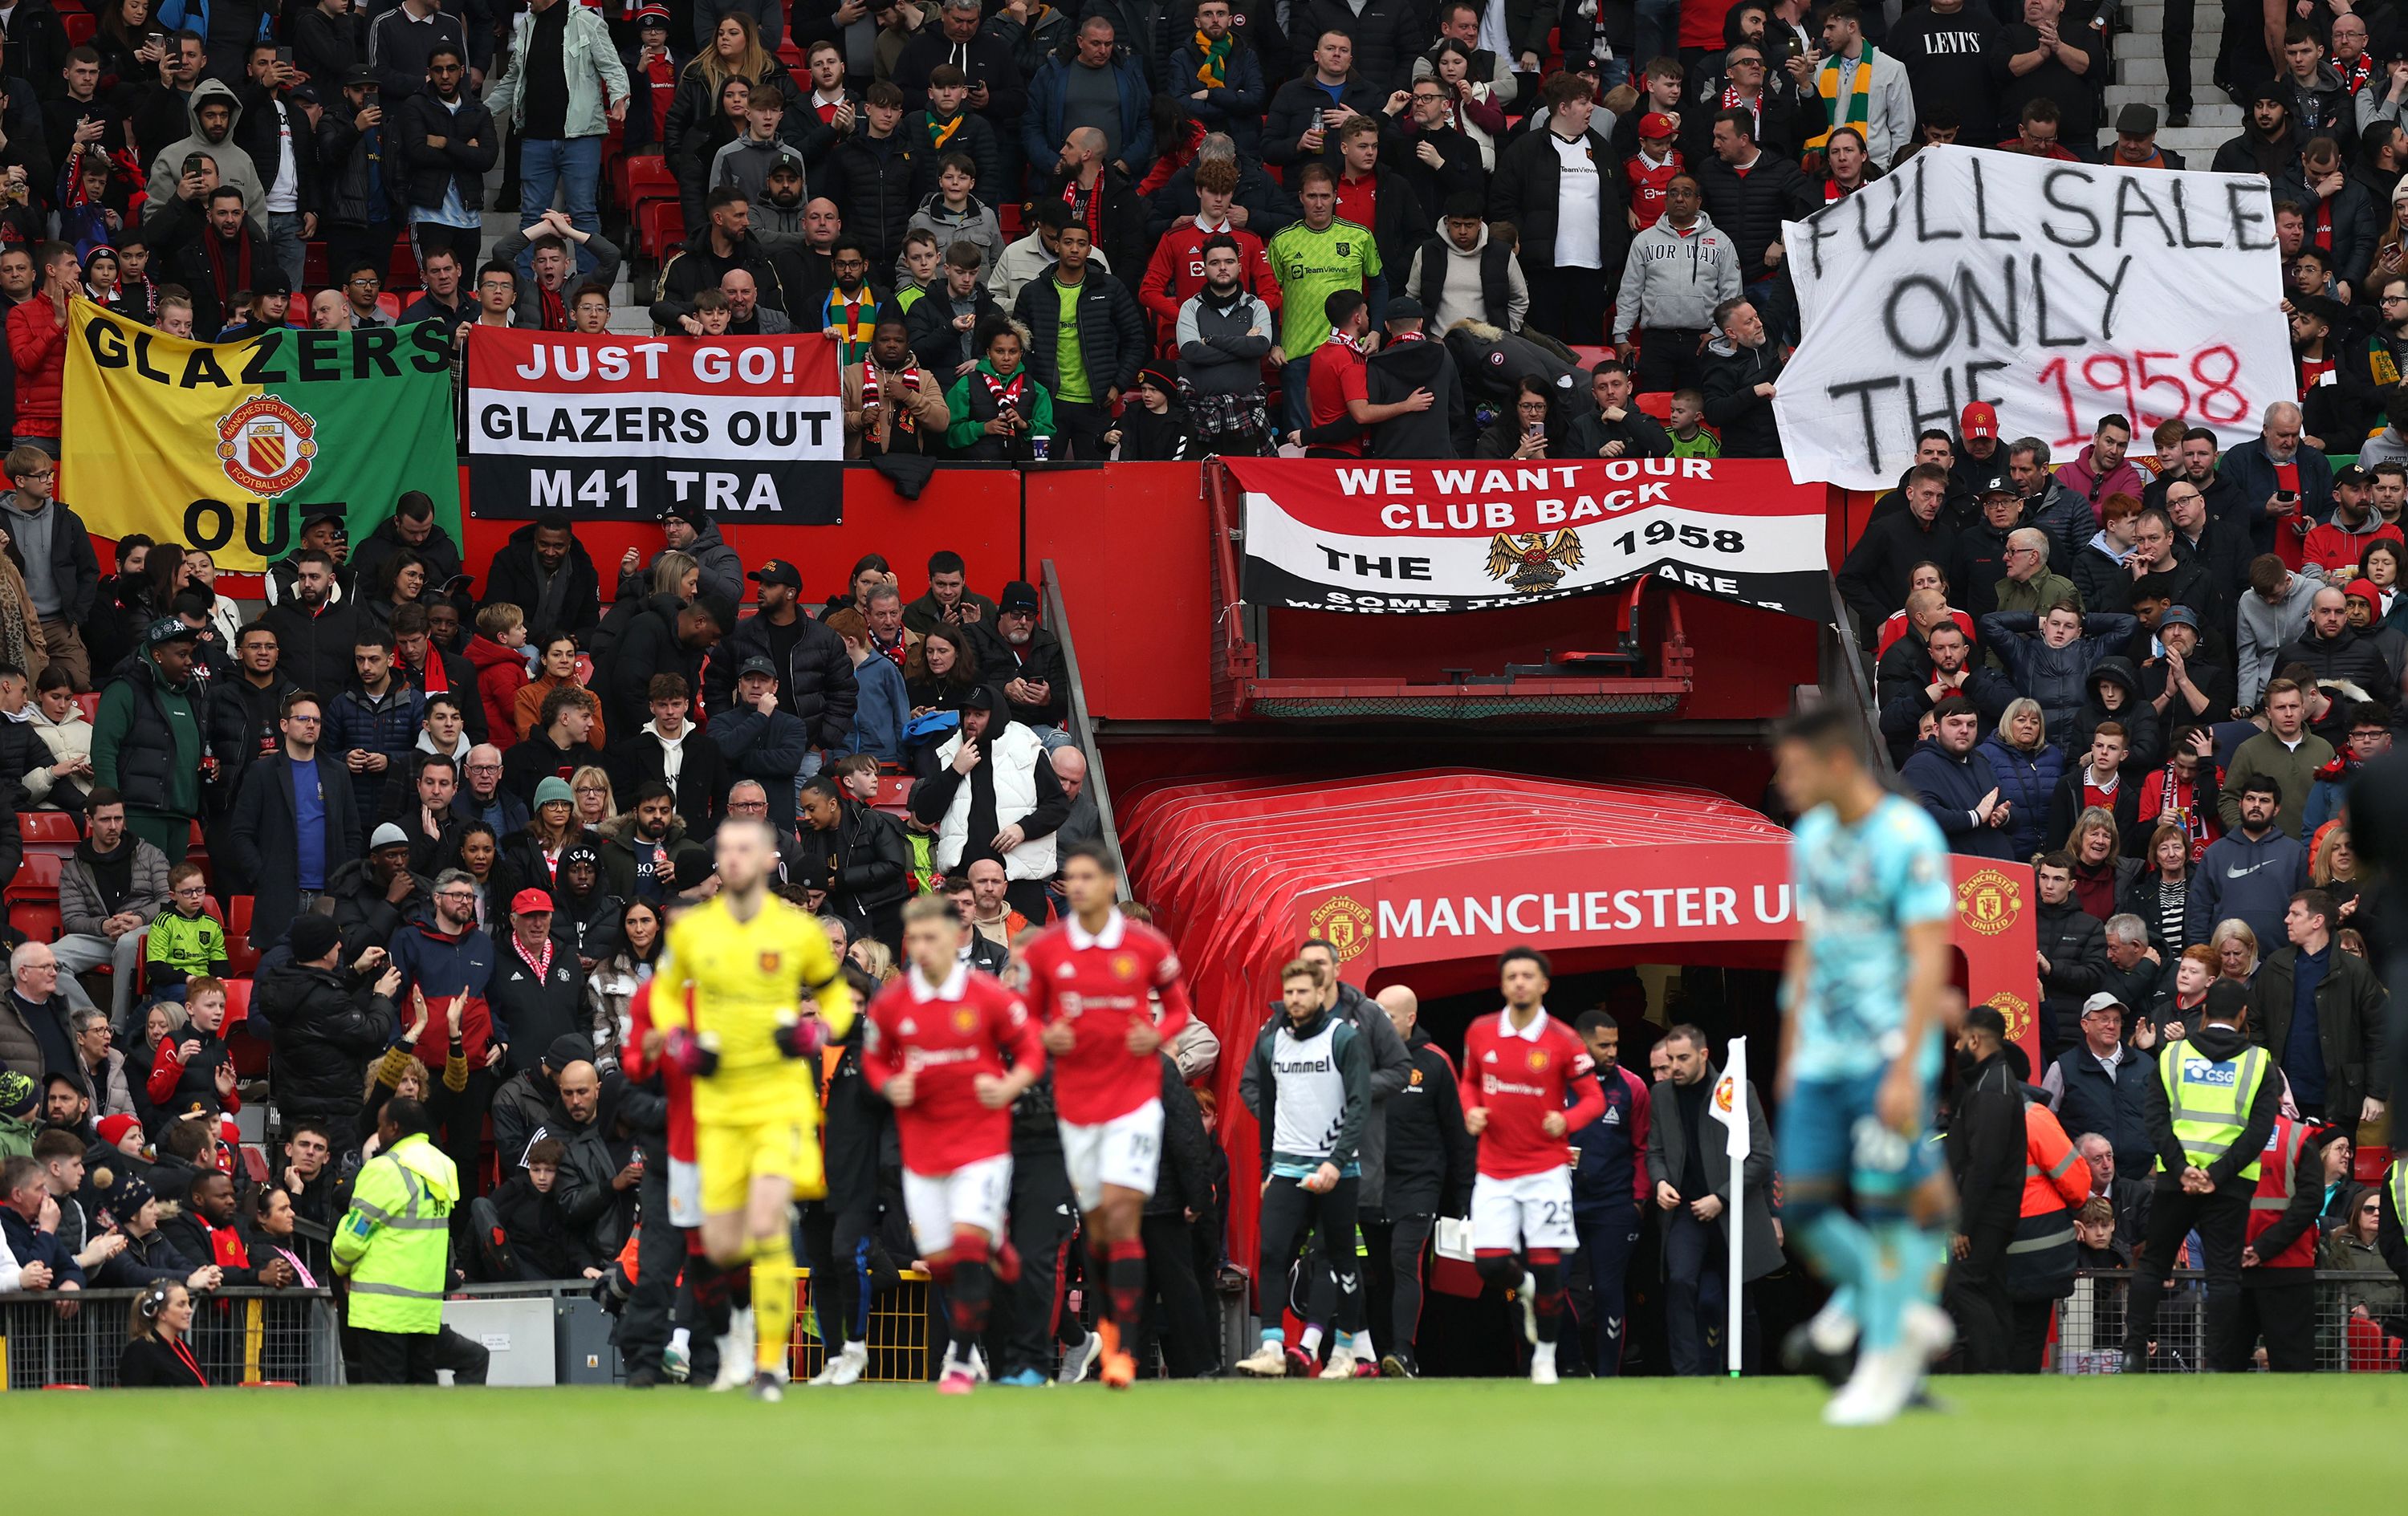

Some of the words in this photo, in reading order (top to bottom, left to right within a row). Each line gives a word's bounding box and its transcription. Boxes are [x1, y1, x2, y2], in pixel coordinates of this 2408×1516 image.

[1923, 32, 1979, 55] LEVI'S
[1806, 156, 2021, 279] FULL
[2041, 167, 2277, 250] SALE
[1646, 244, 1677, 262] NOR
[1684, 244, 1721, 266] WAY
[1304, 266, 1348, 274] TeamViewer
[1883, 252, 2132, 359] ONLY
[83, 319, 451, 389] GLAZERS
[516, 343, 668, 380] JUST
[692, 347, 795, 384] GO!
[226, 404, 277, 436] MANCHESTER
[279, 410, 307, 435] UNITED
[1827, 361, 2010, 475] THE
[2038, 344, 2249, 446] 1958
[481, 404, 709, 444] GLAZERS
[727, 411, 831, 446] OUT
[232, 467, 278, 490] FOOTBALL
[280, 465, 303, 487] CLUB
[530, 469, 637, 509] M41
[666, 471, 783, 511] TRA
[1335, 468, 1414, 495] WE
[1431, 465, 1583, 494] WANT
[1605, 458, 1713, 482] OUR
[1988, 477, 2001, 489] 5
[1381, 502, 1515, 530] CLUB
[1536, 482, 1672, 526] BACK
[1316, 543, 1433, 581] THE
[1613, 520, 1745, 555] 1958
[1326, 591, 1453, 609] SOME
[1658, 563, 1739, 595] ARE
[569, 849, 596, 862] ICON
[1965, 873, 2014, 897] MANCHESTER
[1315, 900, 1366, 924] MANCHESTER
[1378, 883, 1740, 939] MANCHESTER
[1971, 919, 2007, 931] UNITED
[1338, 946, 1360, 957] ITED
[1273, 1055, 1330, 1073] hummel
[2205, 1068, 2235, 1083] CSG
[1544, 1201, 1571, 1225] 25
